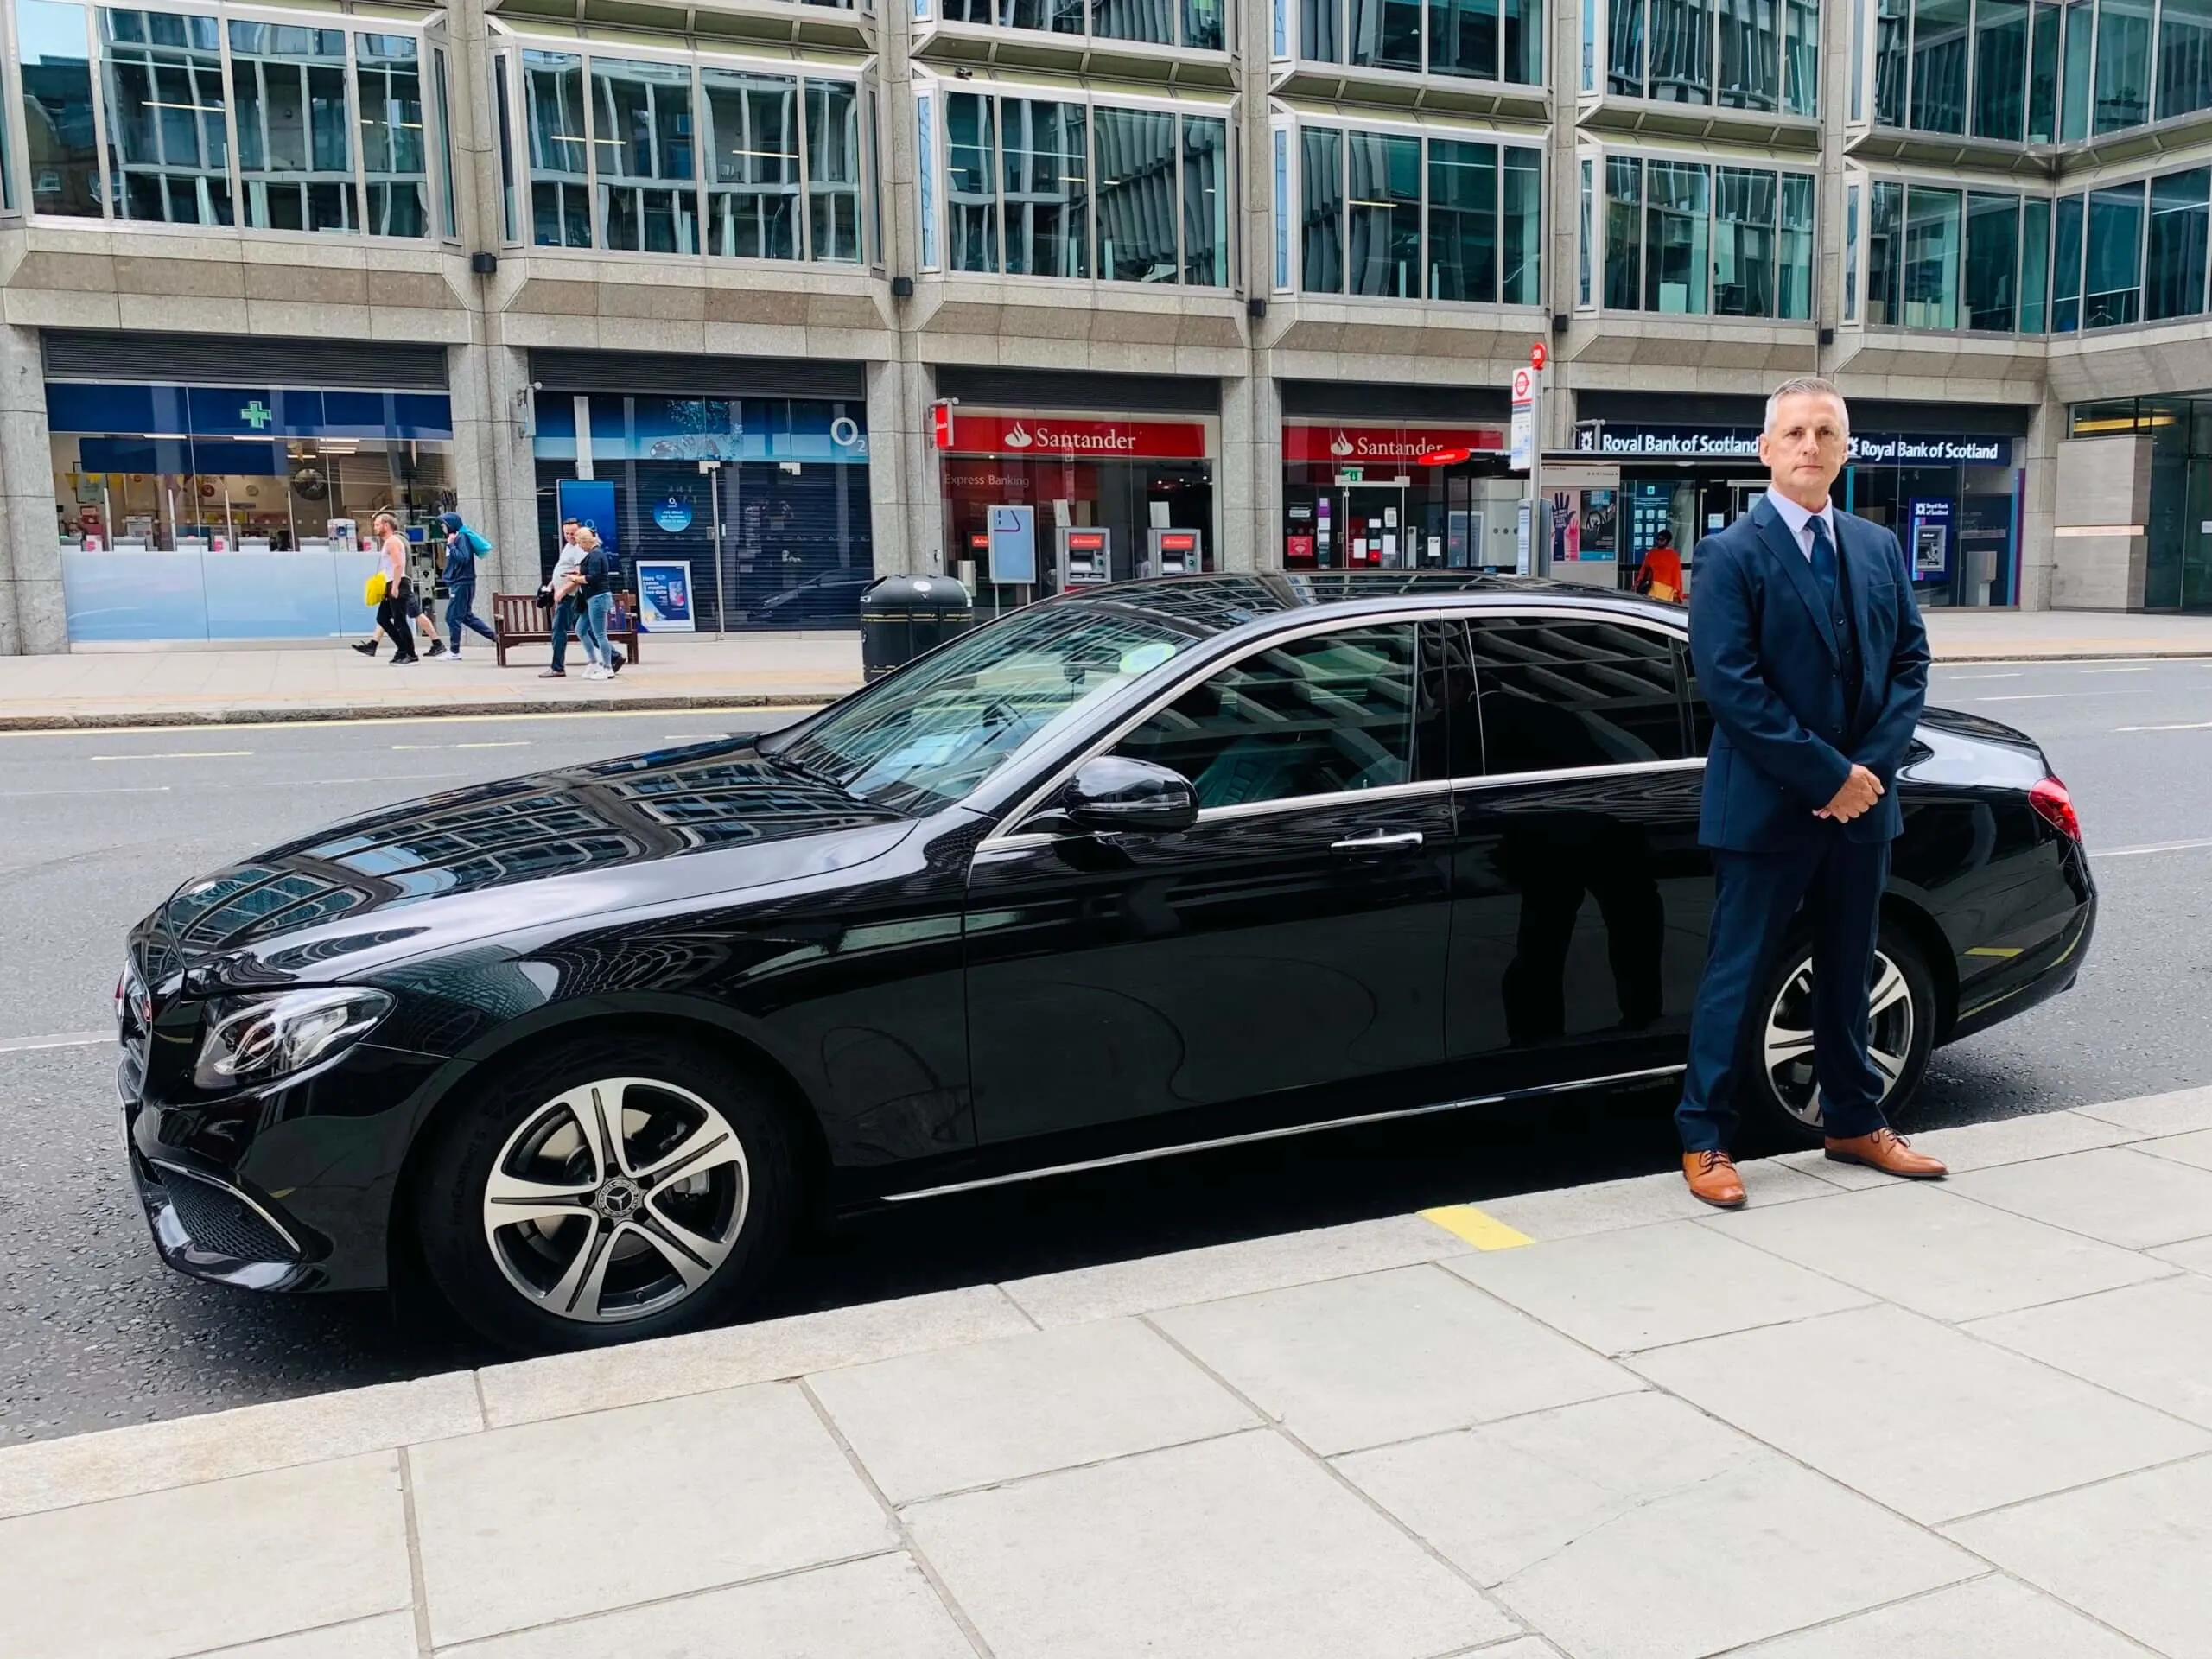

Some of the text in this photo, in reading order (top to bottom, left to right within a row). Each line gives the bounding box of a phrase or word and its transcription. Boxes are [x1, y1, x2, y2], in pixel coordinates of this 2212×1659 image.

[1036, 427, 1136, 449] Santander
[1357, 436, 1443, 456] Santander
[1603, 434, 1760, 453] Royal Bank of Scotland
[1861, 440, 1999, 461] Royal Bank of Scotland
[944, 473, 1030, 488] Express Banking
